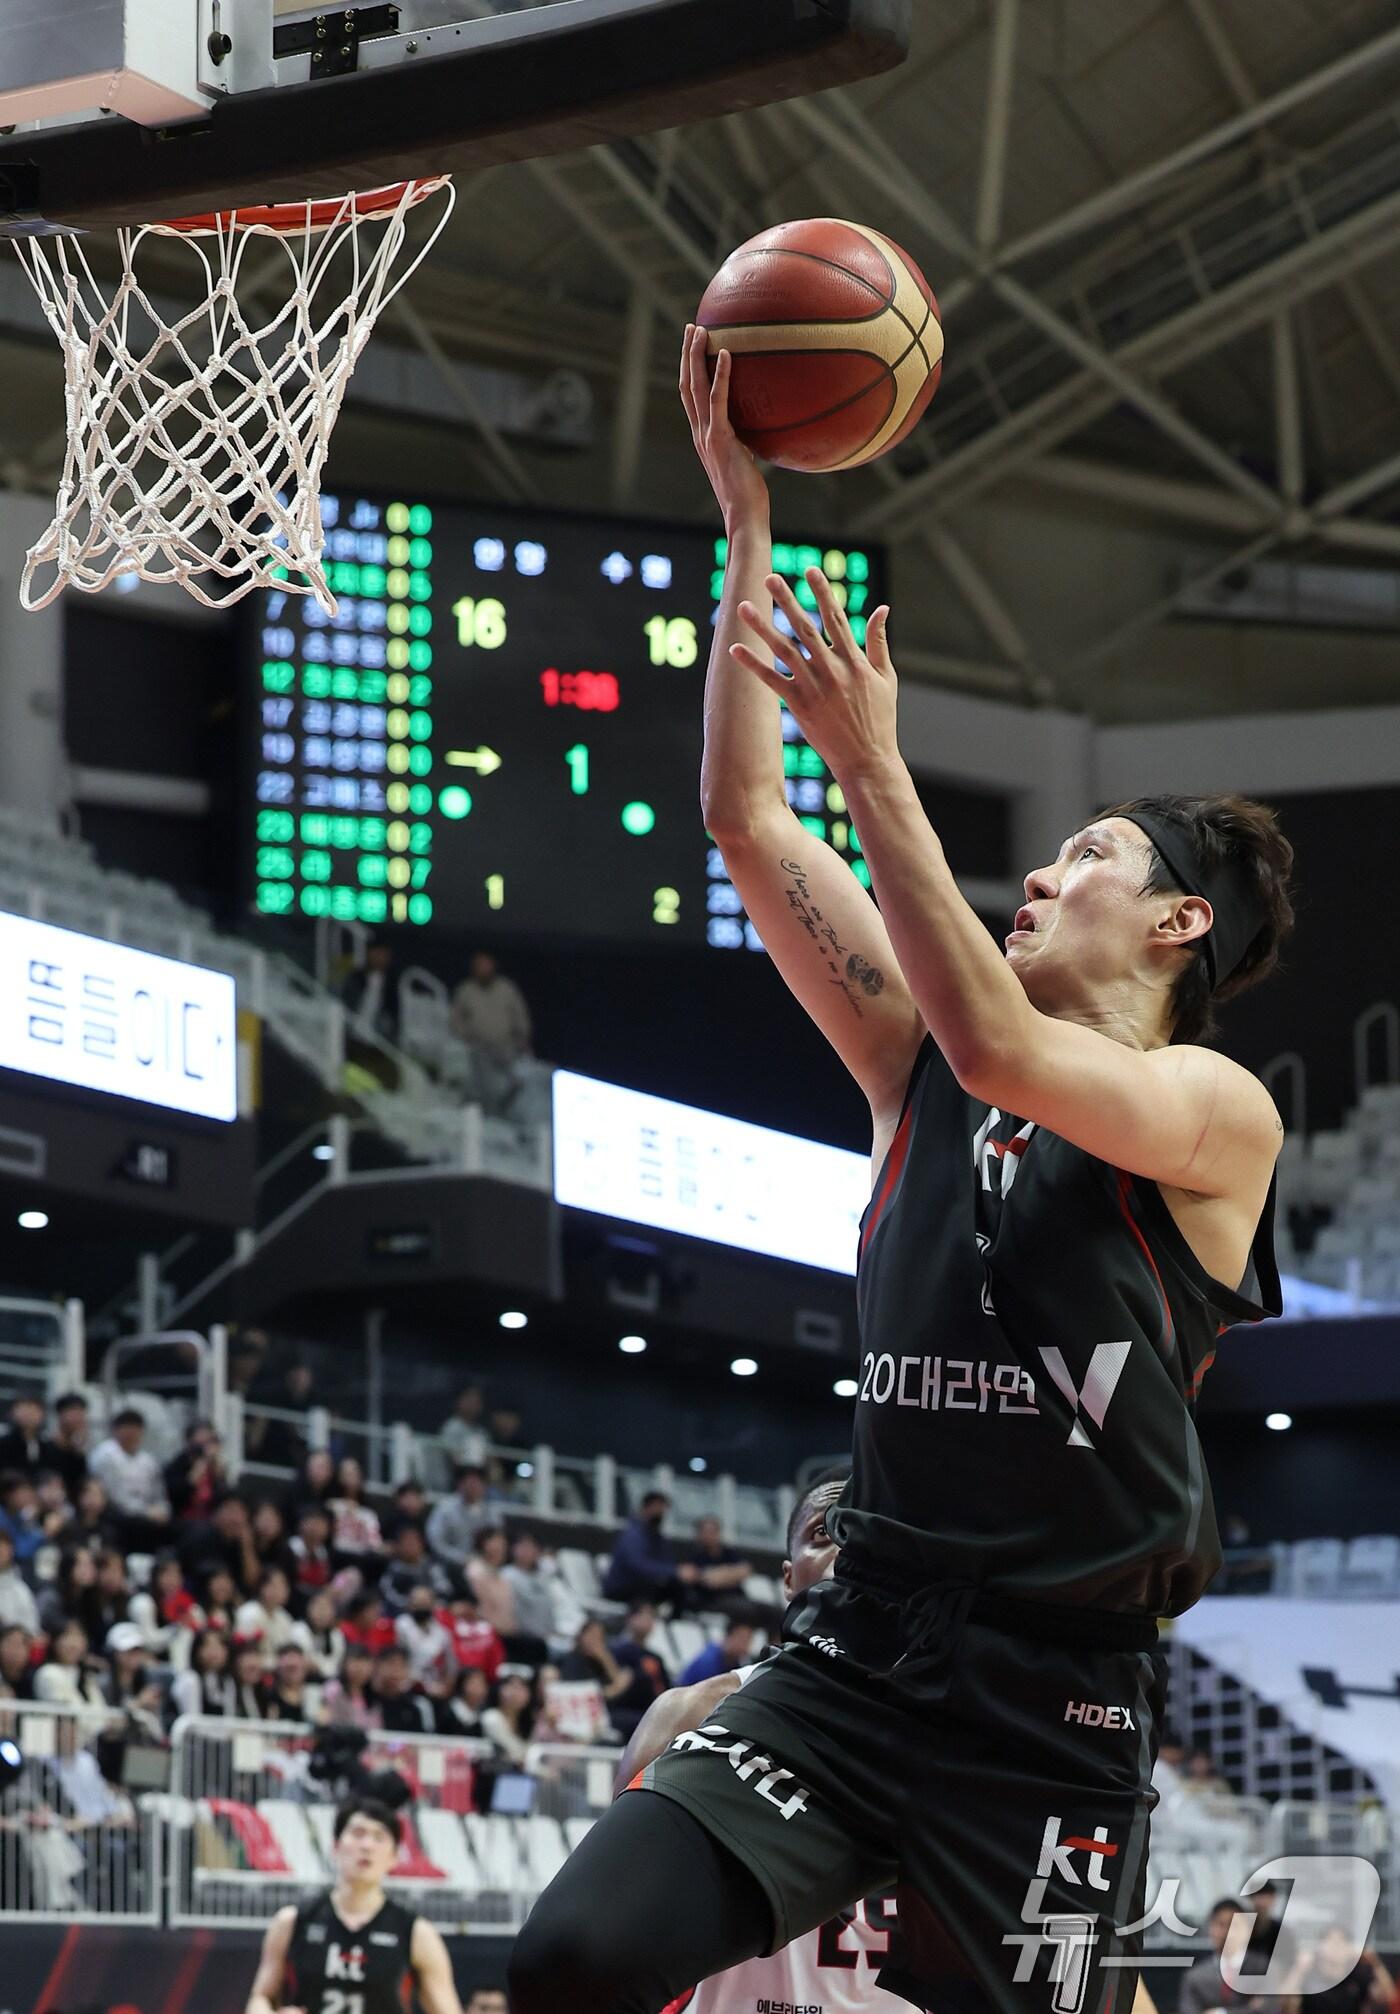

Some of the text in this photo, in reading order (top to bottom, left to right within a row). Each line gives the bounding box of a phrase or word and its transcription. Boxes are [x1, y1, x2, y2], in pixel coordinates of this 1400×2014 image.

[452, 595, 507, 650] 16
[644, 615, 698, 669] 16
[565, 743, 589, 795] 1
[486, 874, 504, 910] 1
[653, 886, 681, 925] 2
[859, 1351, 1041, 1416] 20대라면
[1064, 1700, 1136, 1731] HDEX
[1036, 1815, 1119, 1892] kt
[320, 1988, 365, 2014] 21
